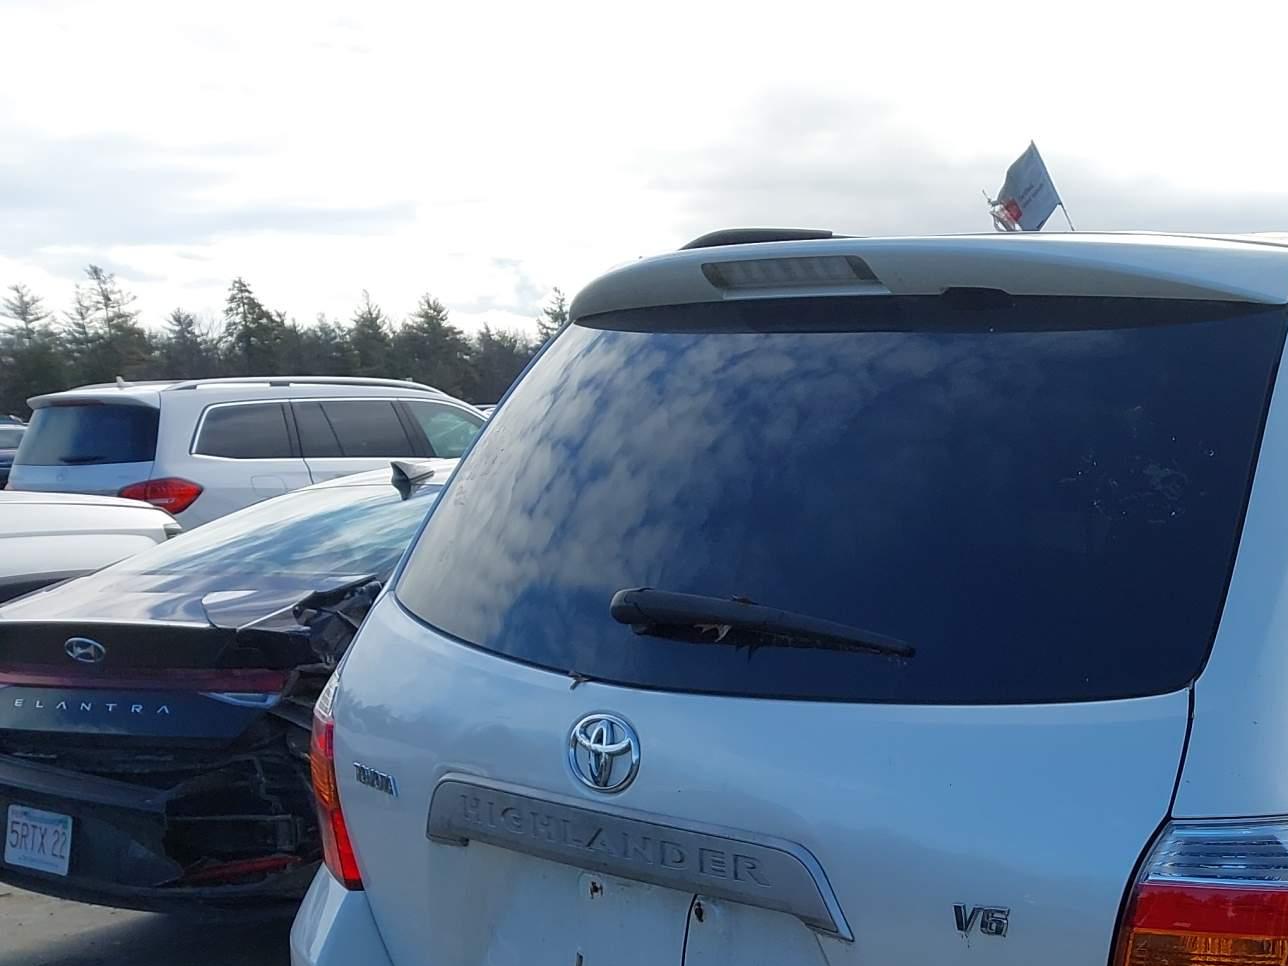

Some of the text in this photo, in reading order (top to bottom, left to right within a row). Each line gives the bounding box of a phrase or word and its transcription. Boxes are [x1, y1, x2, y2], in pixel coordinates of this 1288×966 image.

[14, 698, 170, 714] ELANTRA
[460, 794, 771, 887] HIGHLANDER
[952, 903, 1010, 938] V6
